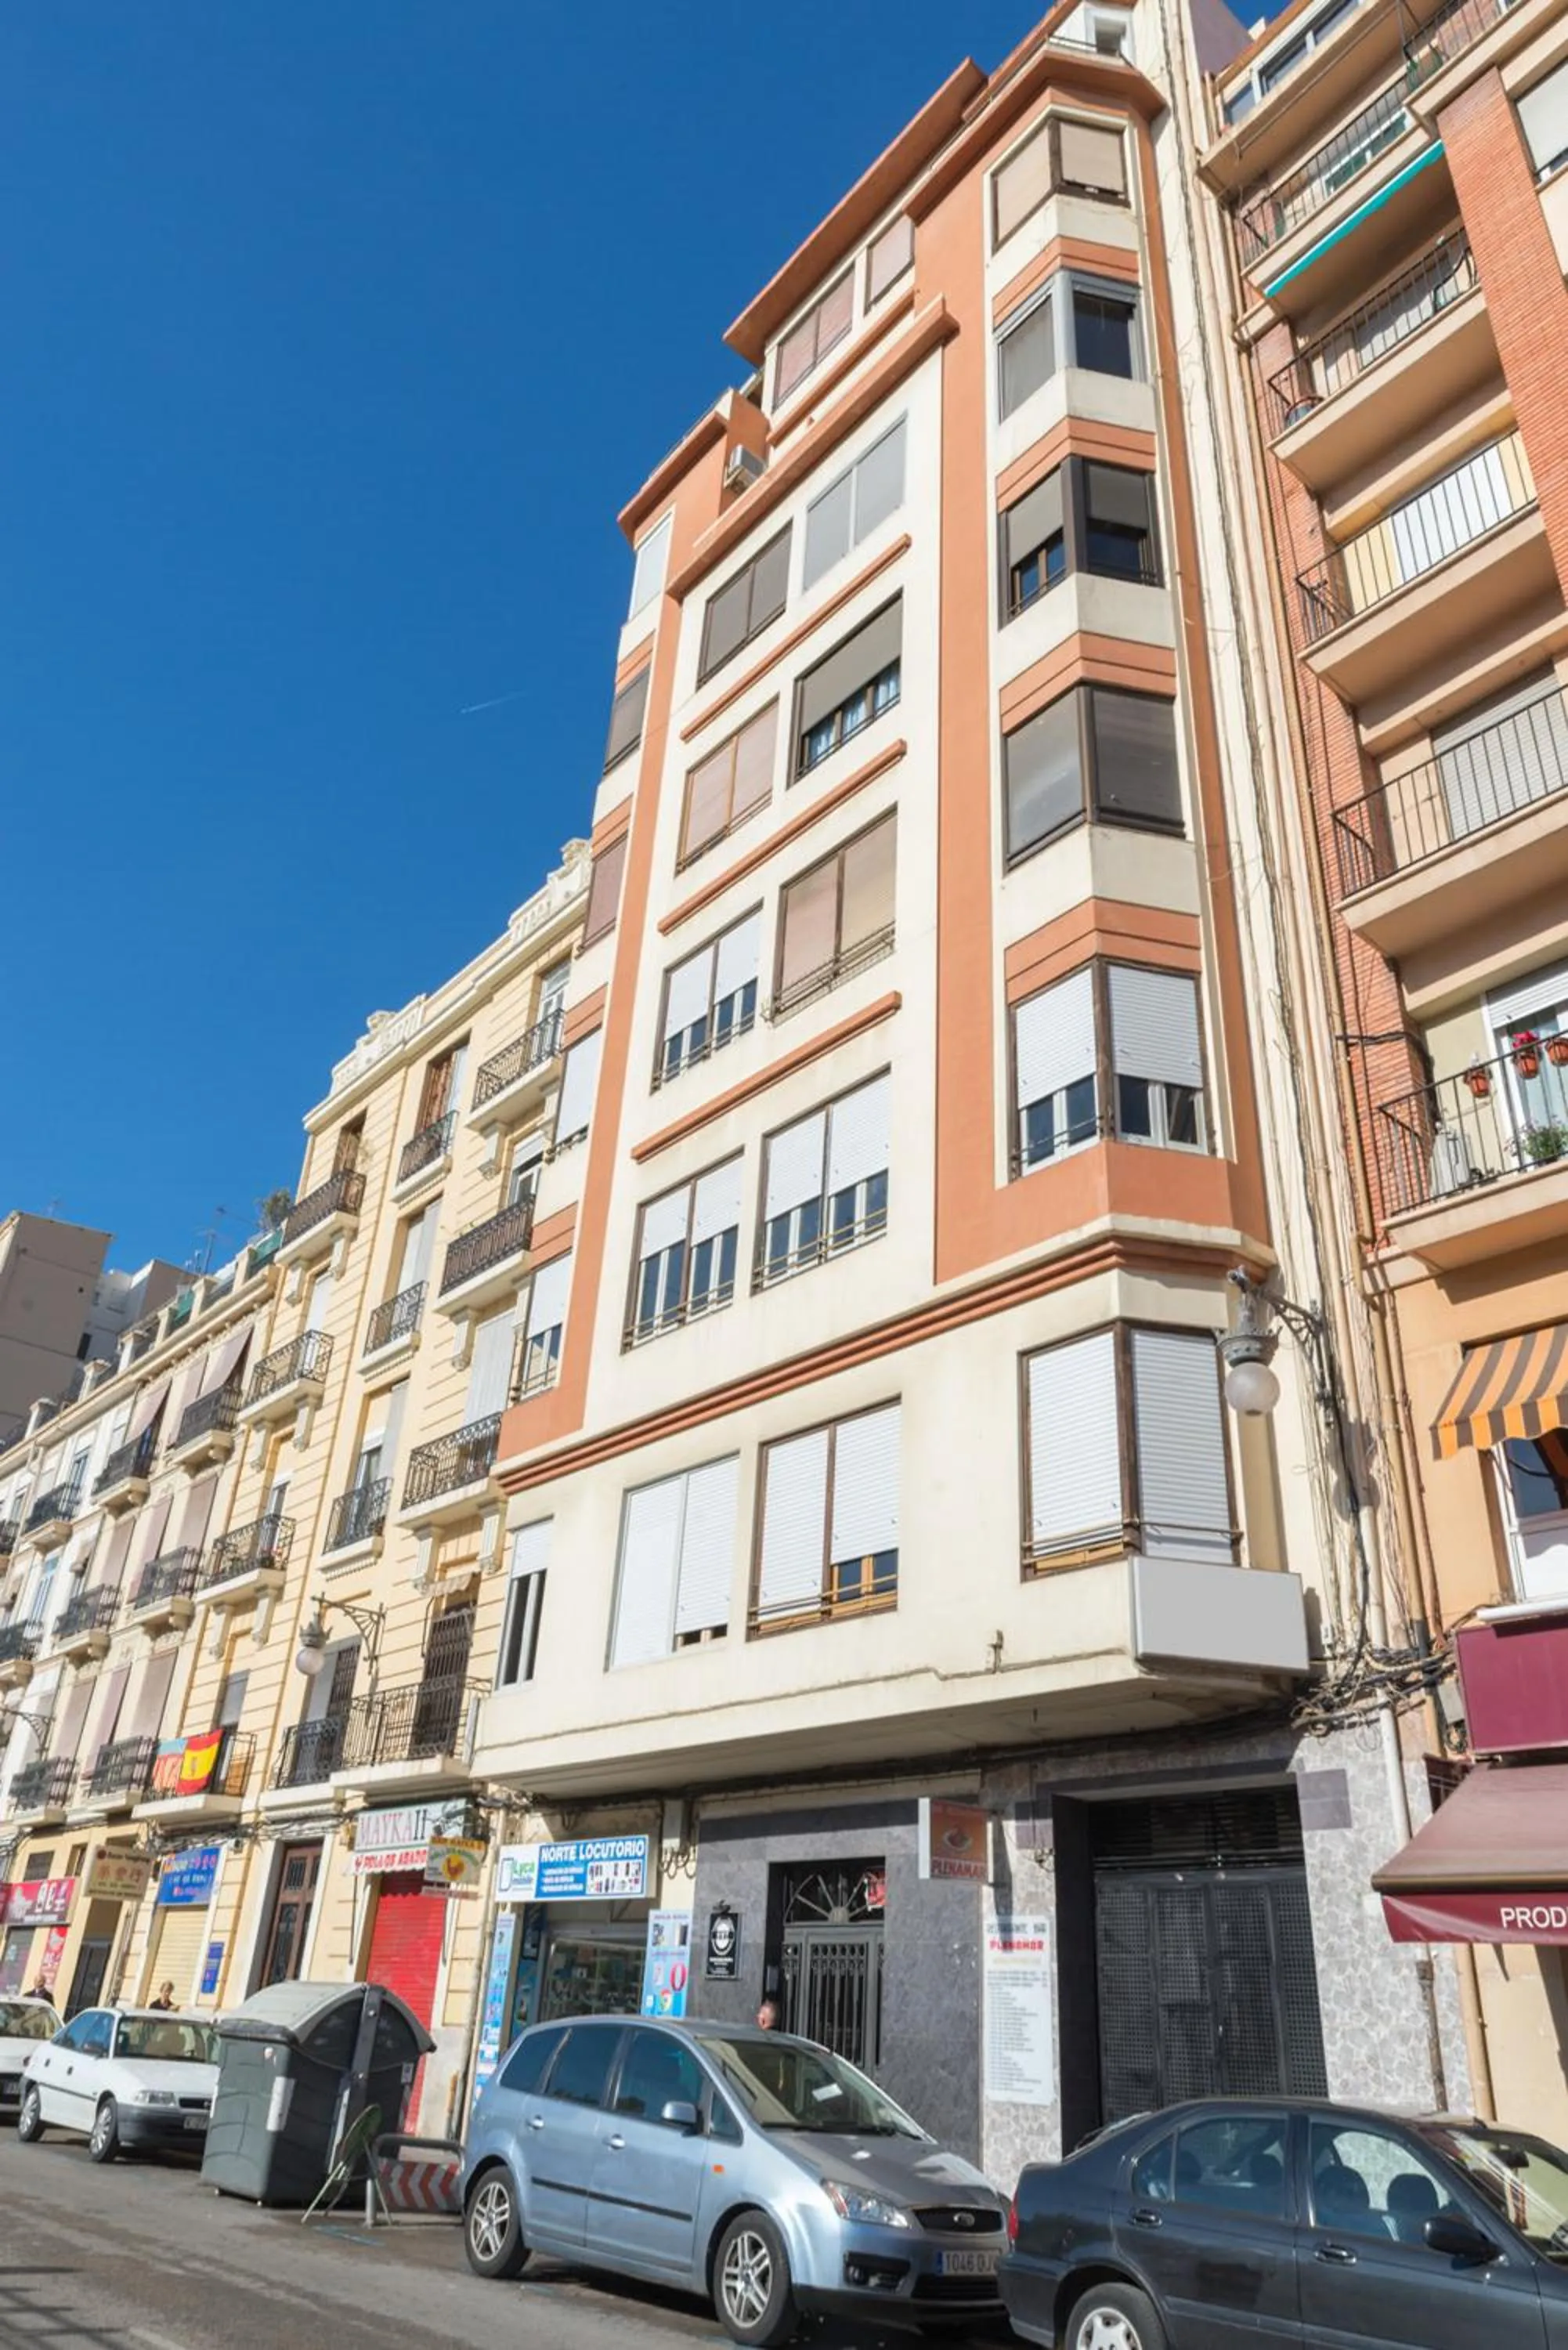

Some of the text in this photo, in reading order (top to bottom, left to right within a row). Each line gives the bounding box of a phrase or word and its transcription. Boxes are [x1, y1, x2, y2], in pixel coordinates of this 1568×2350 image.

[357, 1810, 414, 1848] MAYKA
[364, 1852, 396, 1870] POLLOS
[398, 1848, 428, 1867] ASADO
[540, 1839, 645, 1862] NORTE LOCUTORIO
[930, 1859, 987, 1879] PLENAMAR
[1500, 1906, 1568, 1929] PROD
